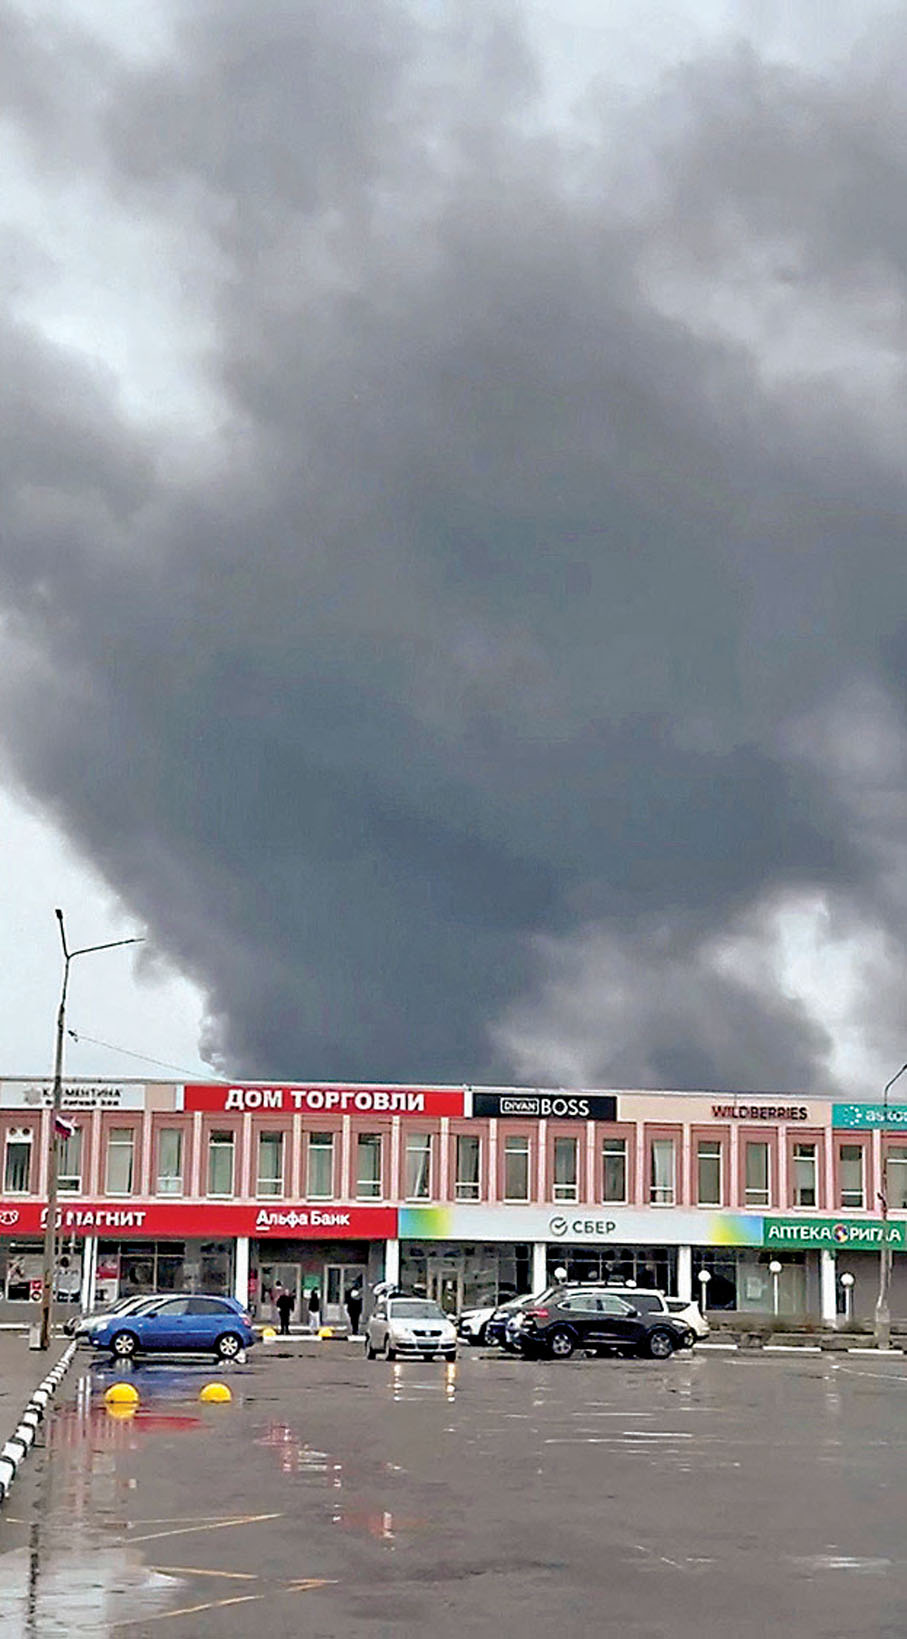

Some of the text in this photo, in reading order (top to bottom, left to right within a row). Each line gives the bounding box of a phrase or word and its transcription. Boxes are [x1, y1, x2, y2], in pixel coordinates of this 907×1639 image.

[225, 1089, 424, 1111] ДОМ ТОРГОВЛИ
[541, 1099, 589, 1116] BOSS
[712, 1106, 808, 1120] WILDBERRIES
[66, 1211, 146, 1226] МАГНИТ
[256, 1210, 350, 1228] Альфа Банк
[572, 1220, 616, 1234] СБЕР
[768, 1226, 831, 1239] АПТЕКА
